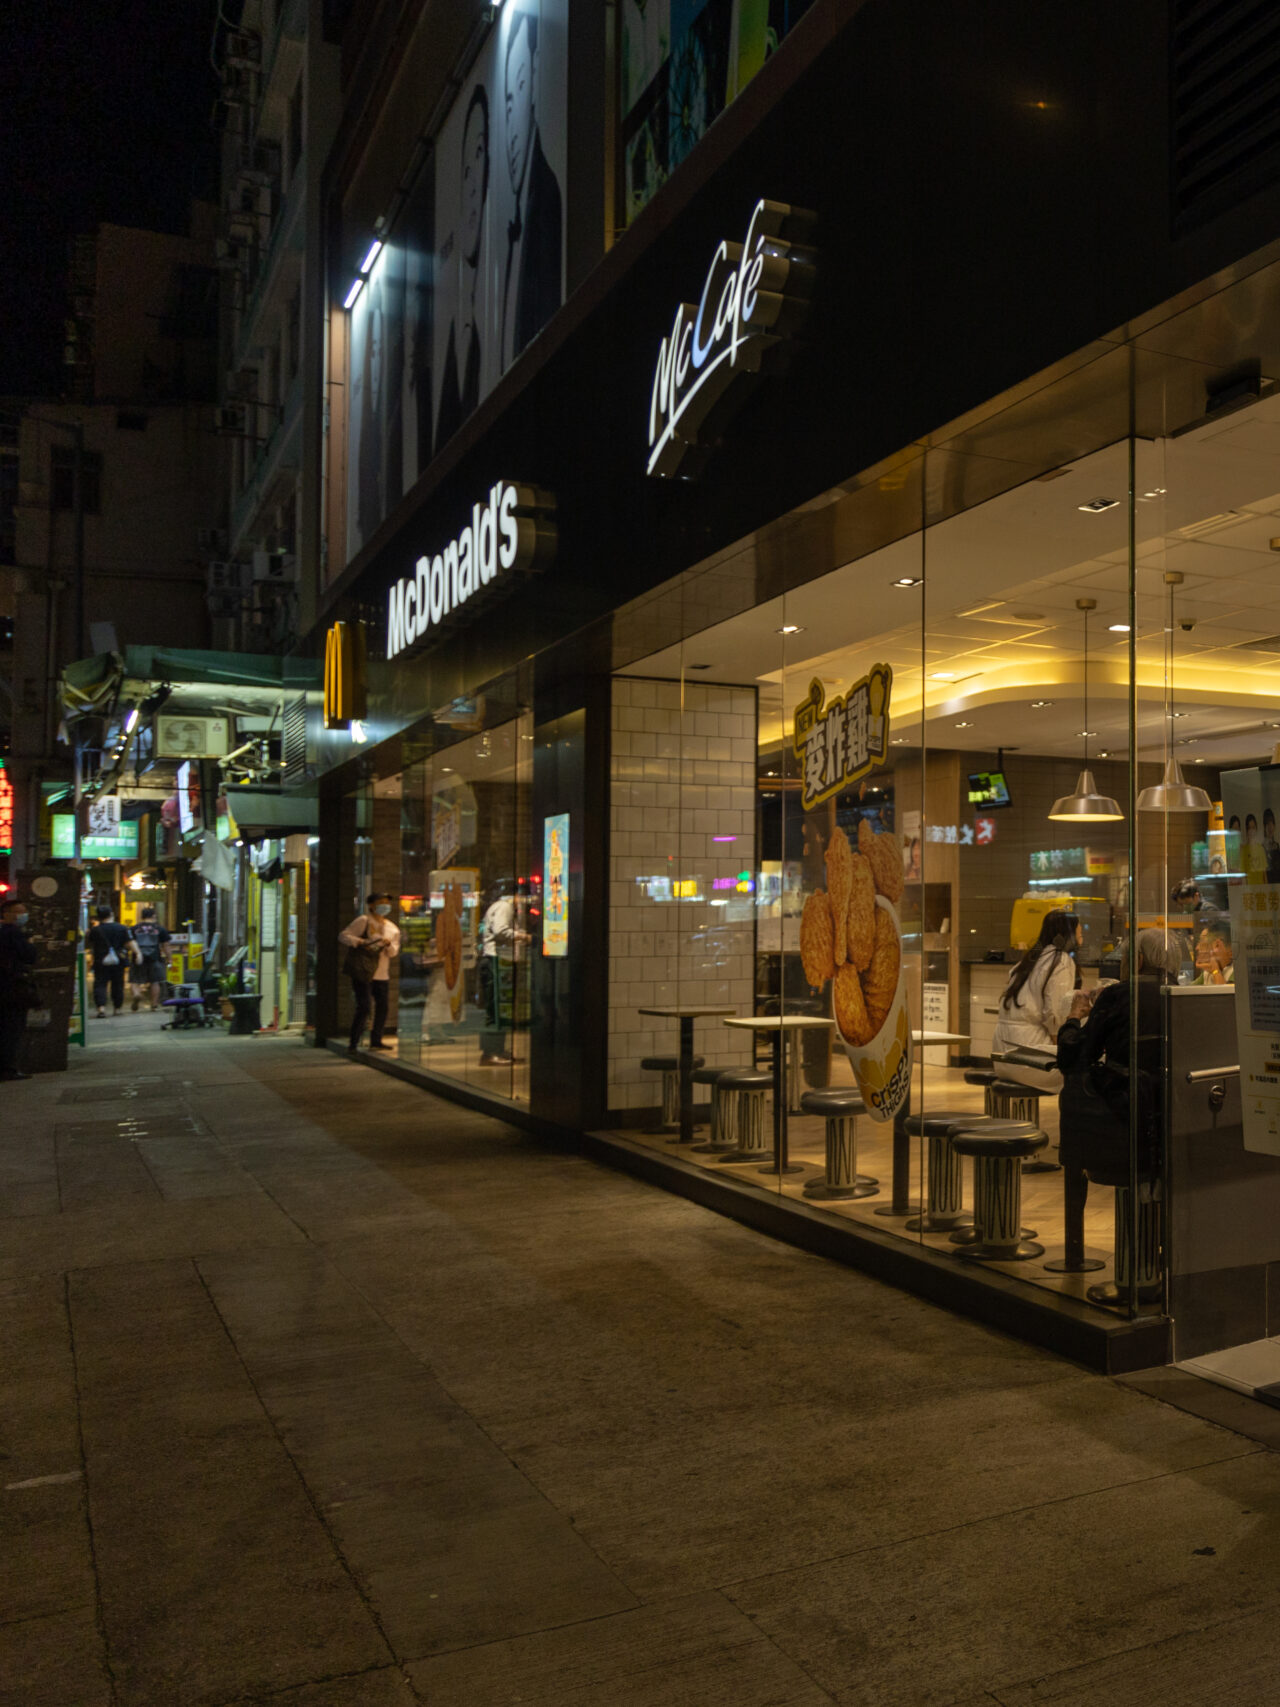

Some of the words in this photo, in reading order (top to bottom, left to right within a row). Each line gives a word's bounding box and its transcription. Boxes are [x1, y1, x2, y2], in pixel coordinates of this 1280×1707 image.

[648, 198, 765, 450] McCafé
[387, 479, 518, 661] McDonald's
[796, 709, 814, 738] NEW
